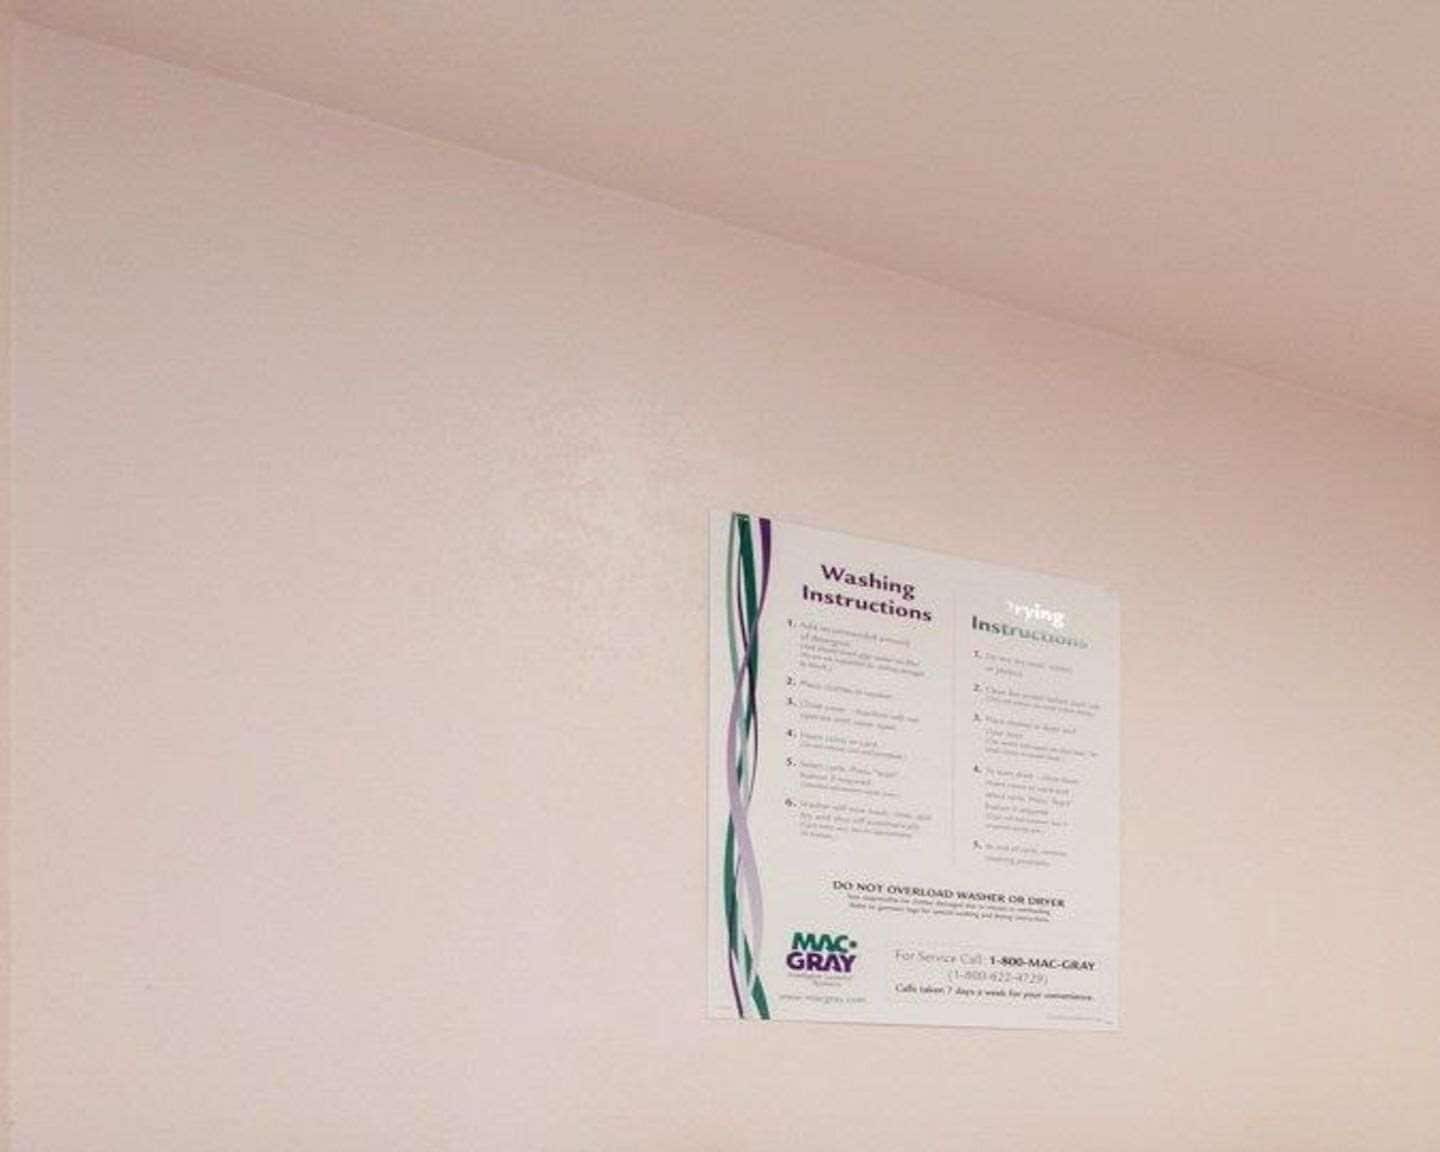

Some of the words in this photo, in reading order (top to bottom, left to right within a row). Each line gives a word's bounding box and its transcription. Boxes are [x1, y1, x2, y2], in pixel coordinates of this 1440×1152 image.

[821, 563, 915, 600] Washing
[803, 584, 932, 621] Instructions
[1005, 600, 1067, 629] rying
[833, 880, 853, 890] DO
[857, 883, 882, 893] NOT
[887, 885, 954, 898] OVERLOAD
[956, 890, 1006, 904] WASHER
[1008, 895, 1025, 905] OR
[1027, 896, 1065, 908] DRYER
[792, 932, 849, 953] MAC
[786, 952, 856, 973] GRAY
[896, 949, 915, 961] For
[990, 955, 1095, 970] 1-800-MAC-GRAY
